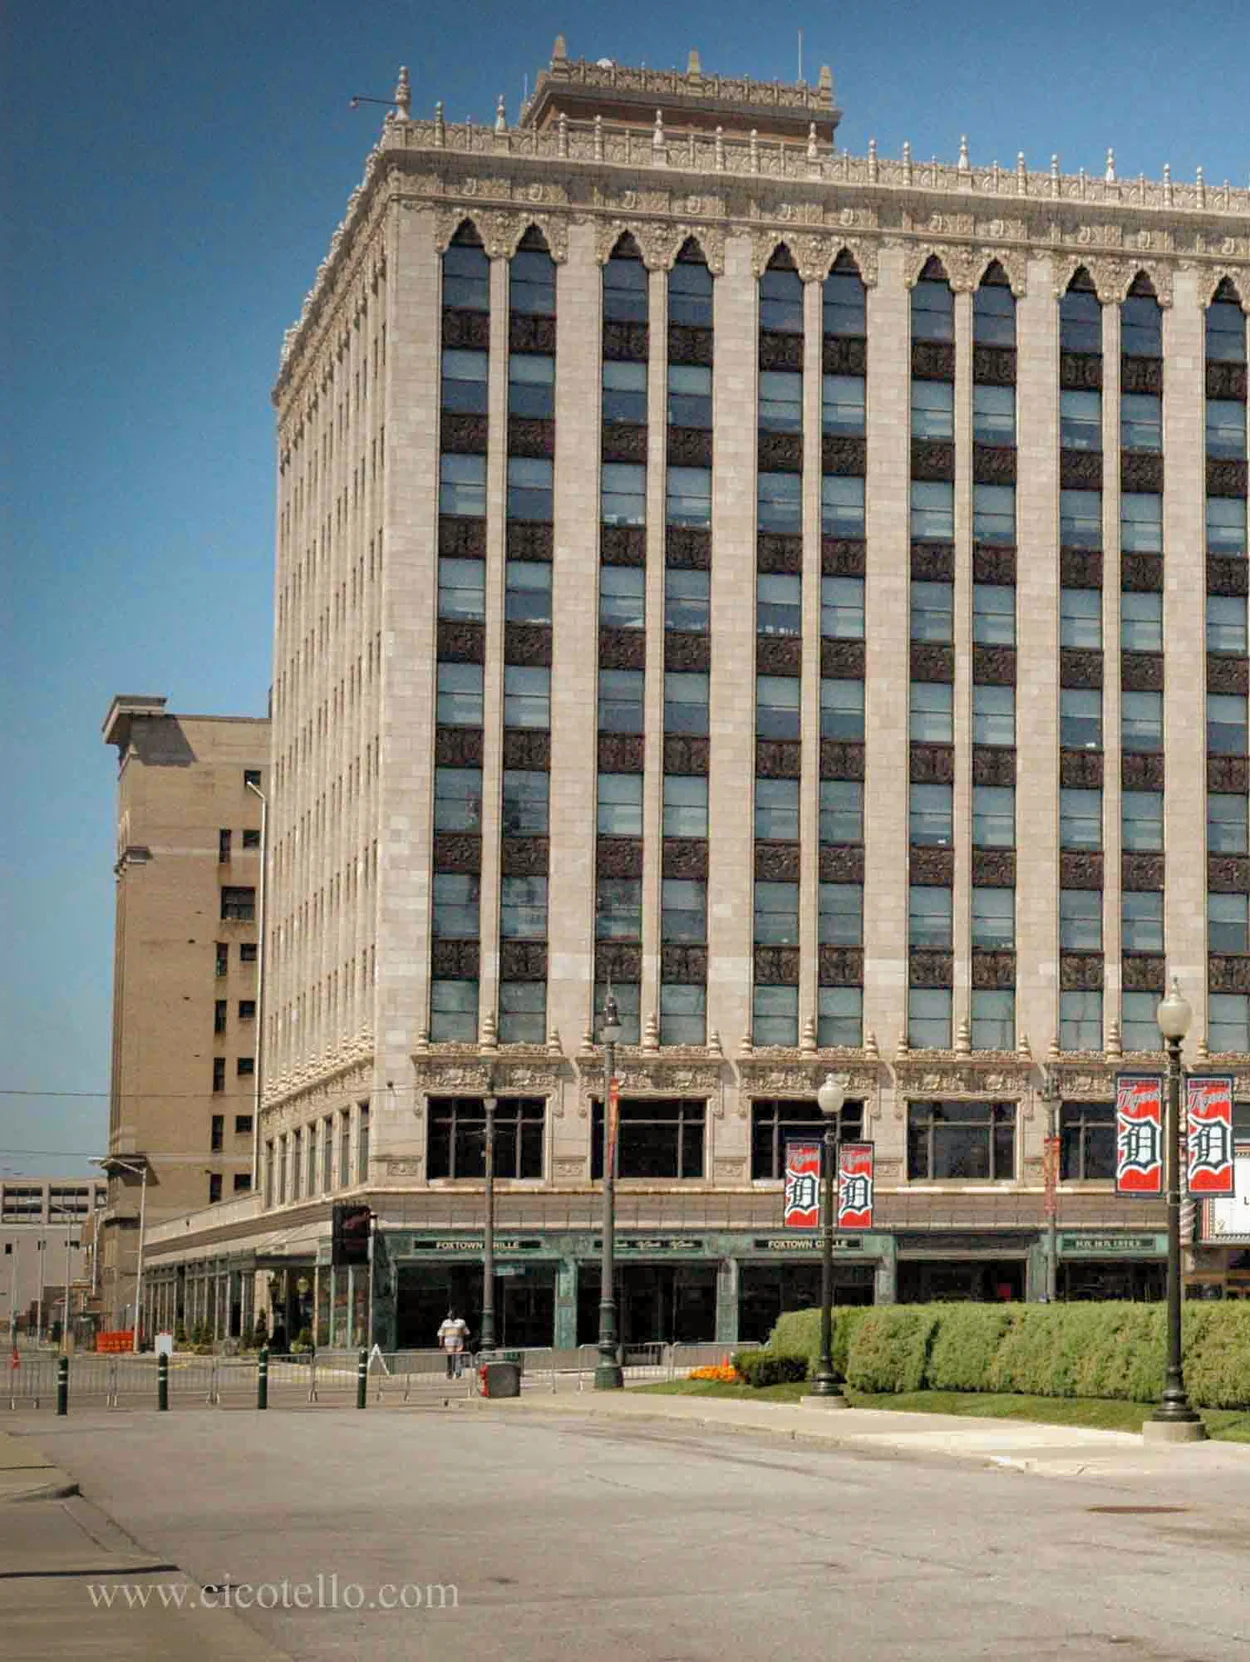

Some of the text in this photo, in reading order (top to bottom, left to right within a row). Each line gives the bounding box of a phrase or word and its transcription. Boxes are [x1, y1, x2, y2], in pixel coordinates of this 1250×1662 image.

[436, 1241, 520, 1250] FOXTOWN RILLE
[768, 1240, 813, 1249] FOXTOWN
